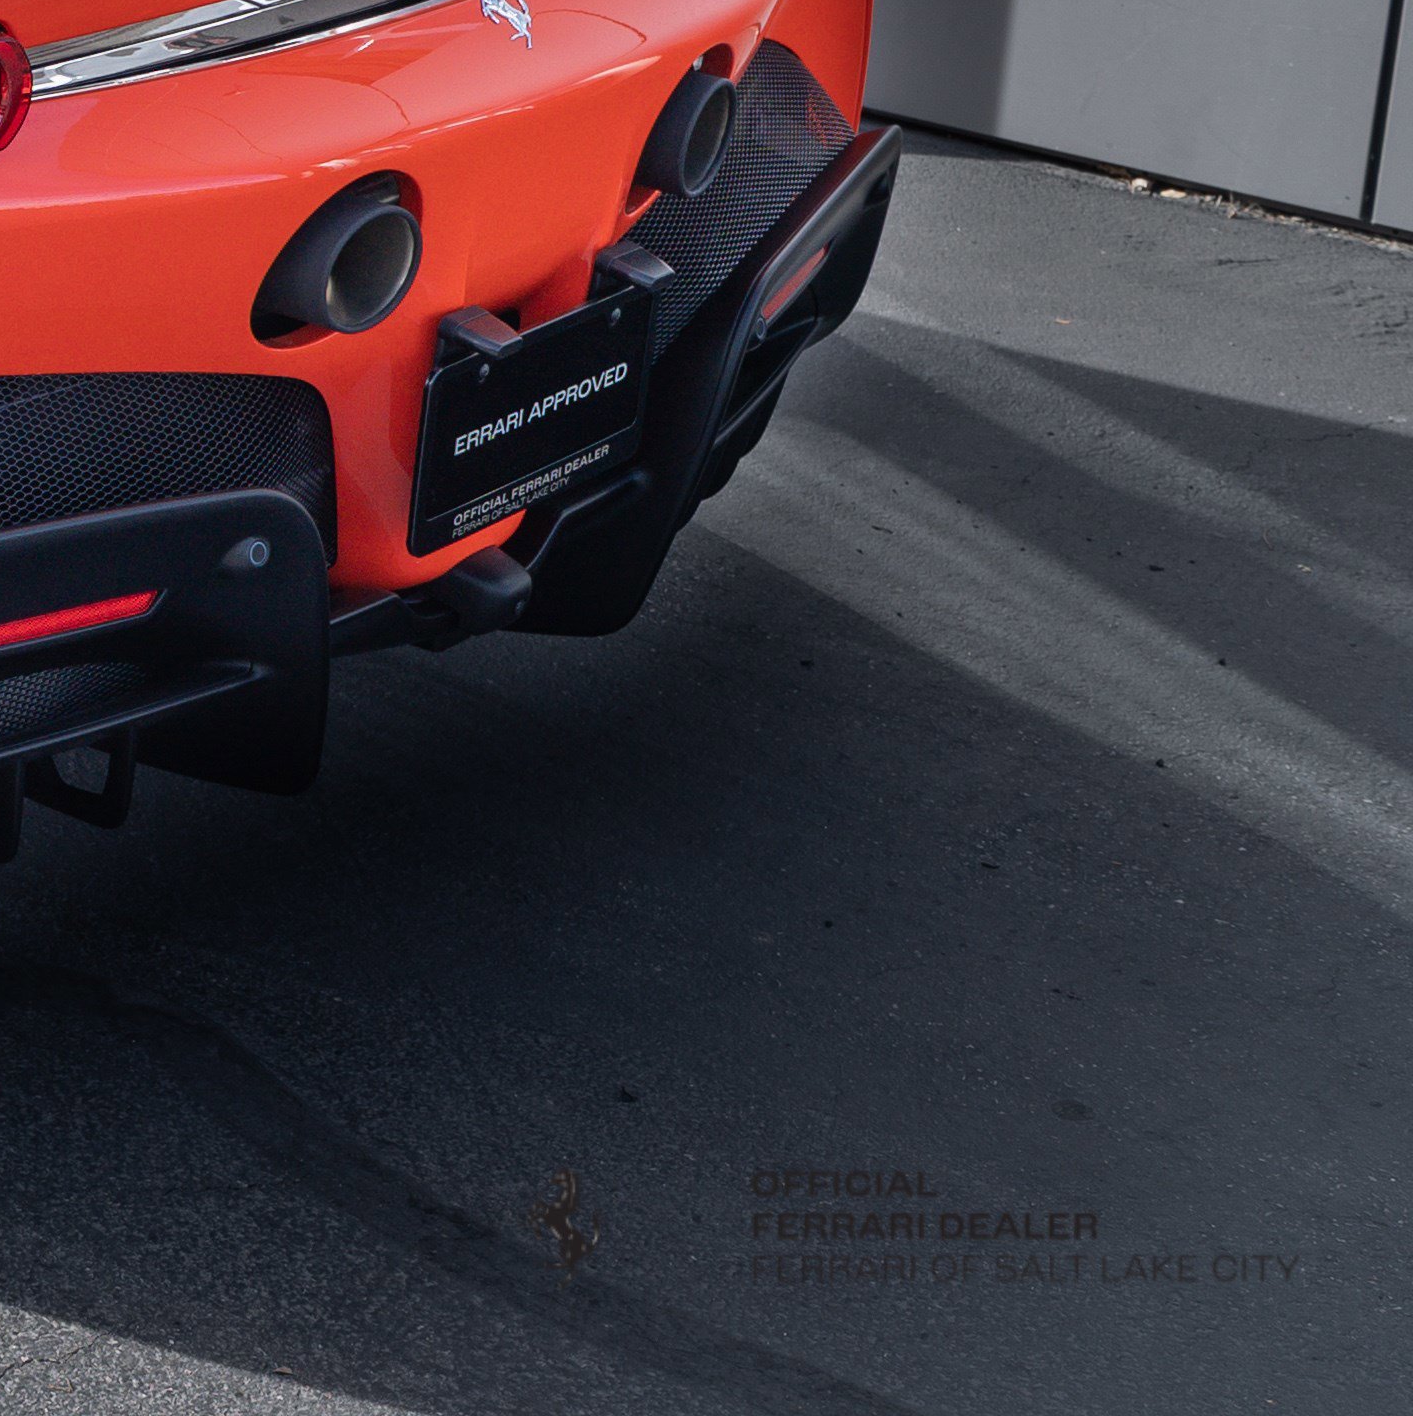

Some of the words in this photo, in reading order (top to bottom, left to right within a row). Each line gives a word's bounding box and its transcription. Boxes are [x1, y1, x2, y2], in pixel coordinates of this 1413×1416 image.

[527, 362, 628, 423] APPROVED
[452, 514, 490, 539] FERRARI
[491, 506, 504, 520] OF
[504, 496, 526, 515] SALT
[526, 485, 550, 503] LAKE
[550, 476, 570, 492] CITY
[453, 492, 509, 526] OFFICIAL
[511, 466, 563, 500] FERRARI
[564, 444, 610, 475] DEALER
